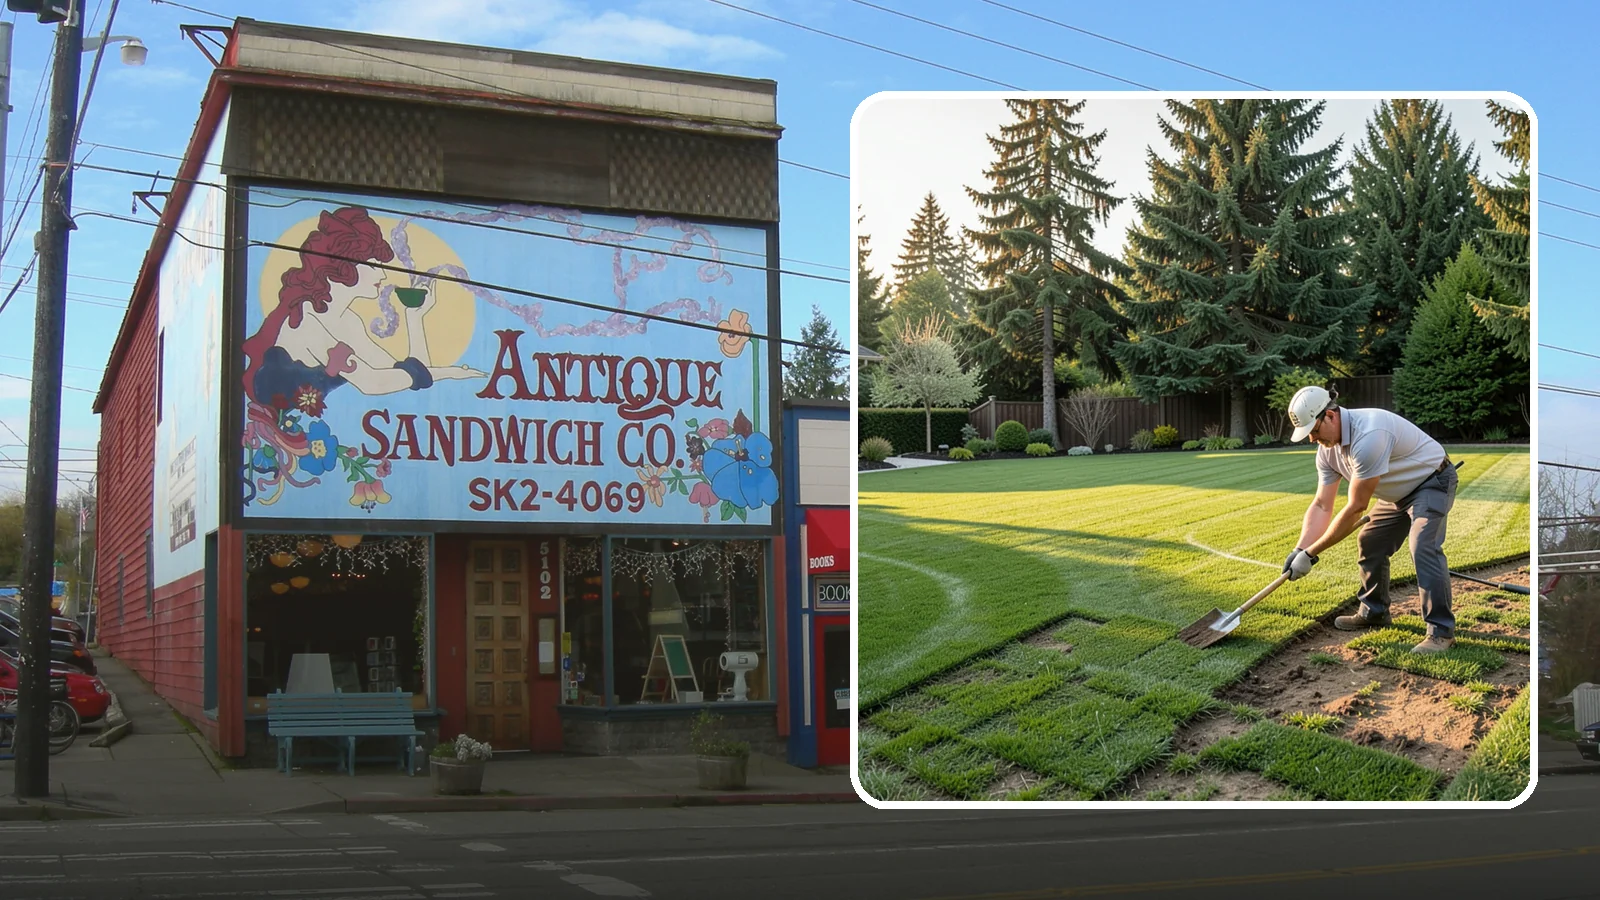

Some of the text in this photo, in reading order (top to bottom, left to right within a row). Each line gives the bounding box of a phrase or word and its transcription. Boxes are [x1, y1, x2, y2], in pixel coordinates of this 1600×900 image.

[476, 329, 724, 421] ANTIQUE
[361, 408, 685, 469] SANDWICH CO.
[468, 477, 646, 513] SK2-4069
[540, 542, 551, 599] 5102
[809, 555, 835, 569] BOOKS
